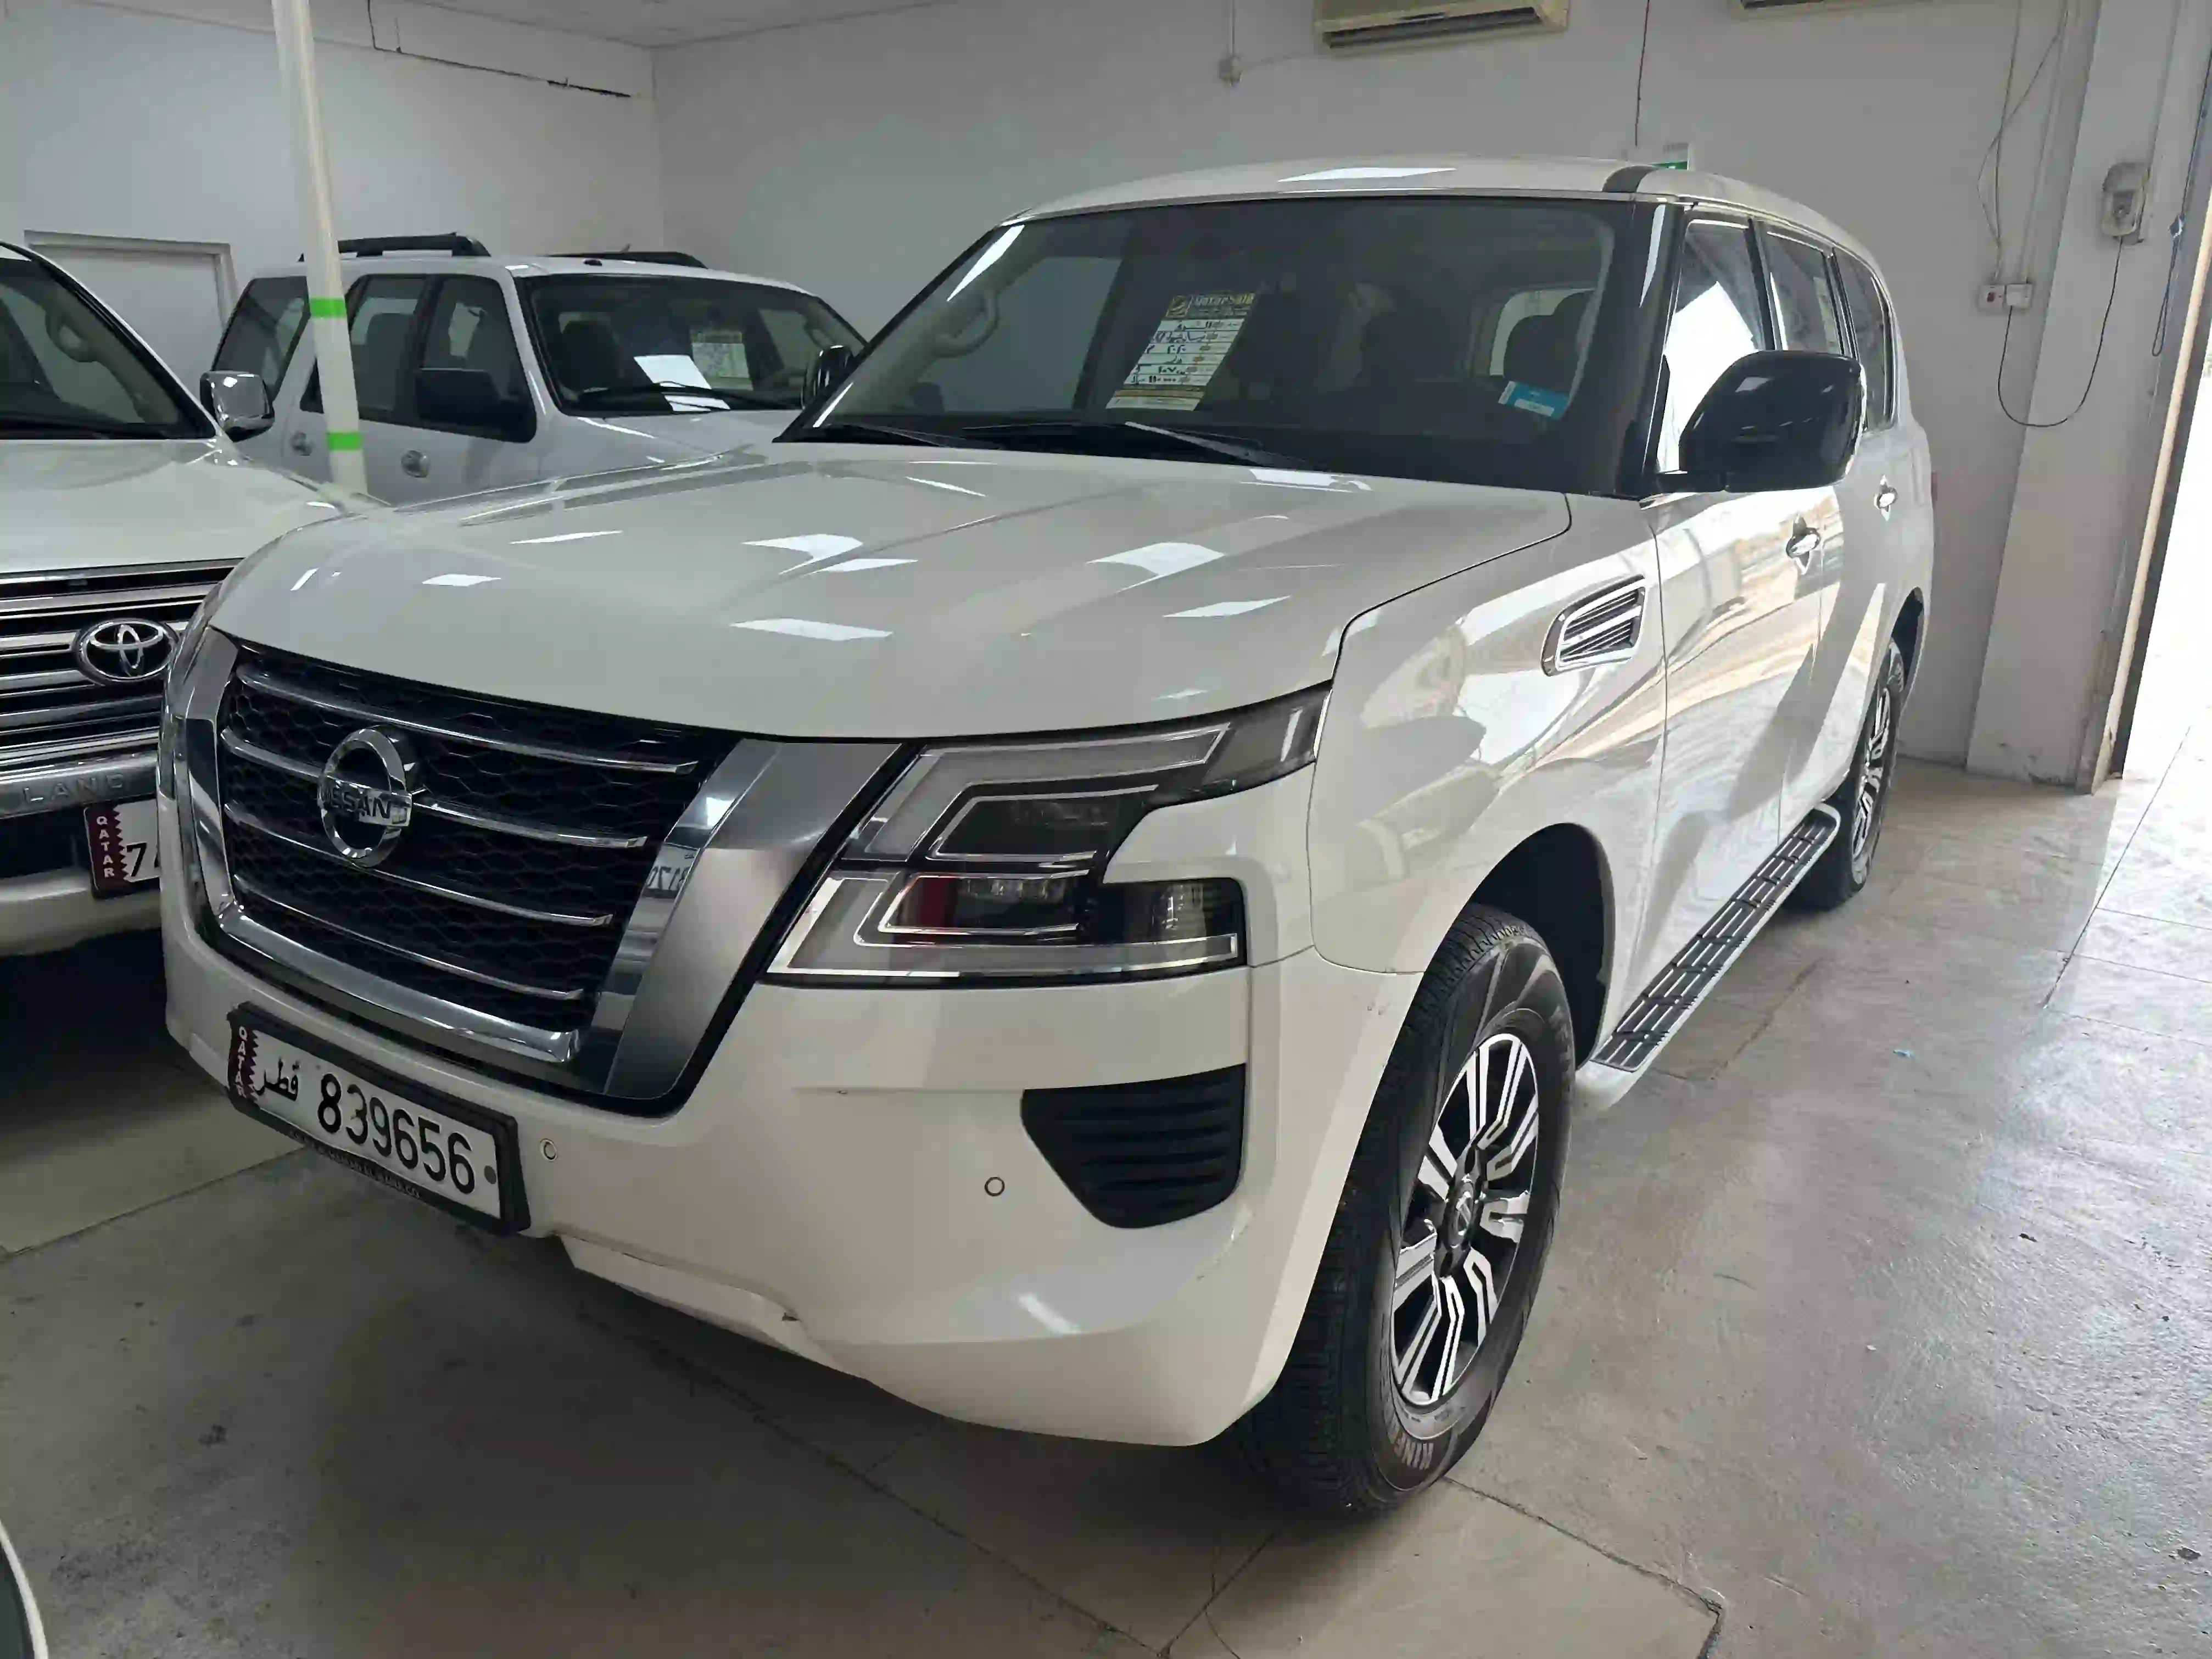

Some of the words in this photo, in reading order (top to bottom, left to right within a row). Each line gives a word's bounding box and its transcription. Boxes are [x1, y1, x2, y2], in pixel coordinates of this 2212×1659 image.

[23, 773, 124, 803] LAND
[96, 816, 115, 878] QATAR
[234, 1026, 248, 1099] QATAR
[253, 1057, 300, 1101] قطر
[317, 1073, 475, 1194] 839656
